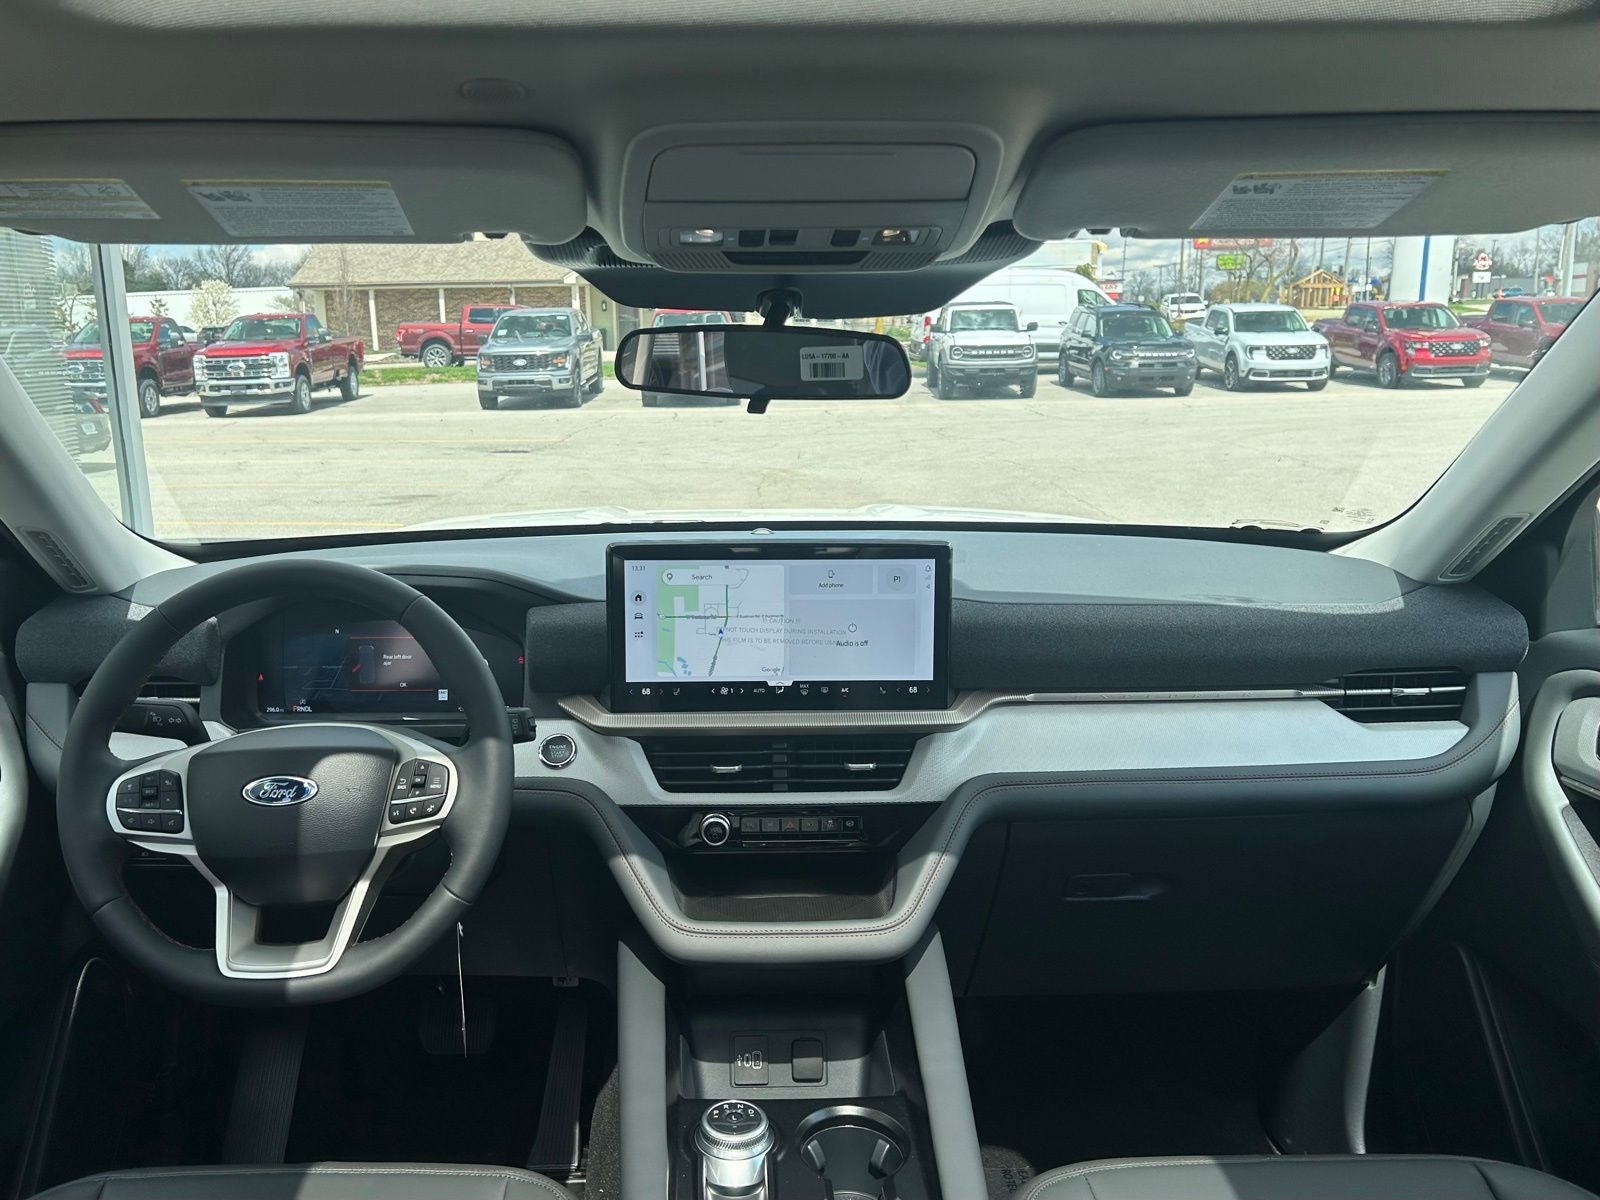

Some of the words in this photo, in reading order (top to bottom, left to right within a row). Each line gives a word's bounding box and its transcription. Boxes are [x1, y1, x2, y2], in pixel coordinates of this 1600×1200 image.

[828, 582, 844, 590] phone
[783, 628, 806, 636] DURING
[836, 640, 854, 648] Audio
[641, 688, 651, 696] 68
[908, 686, 918, 694] 68
[259, 781, 298, 798] Ford
